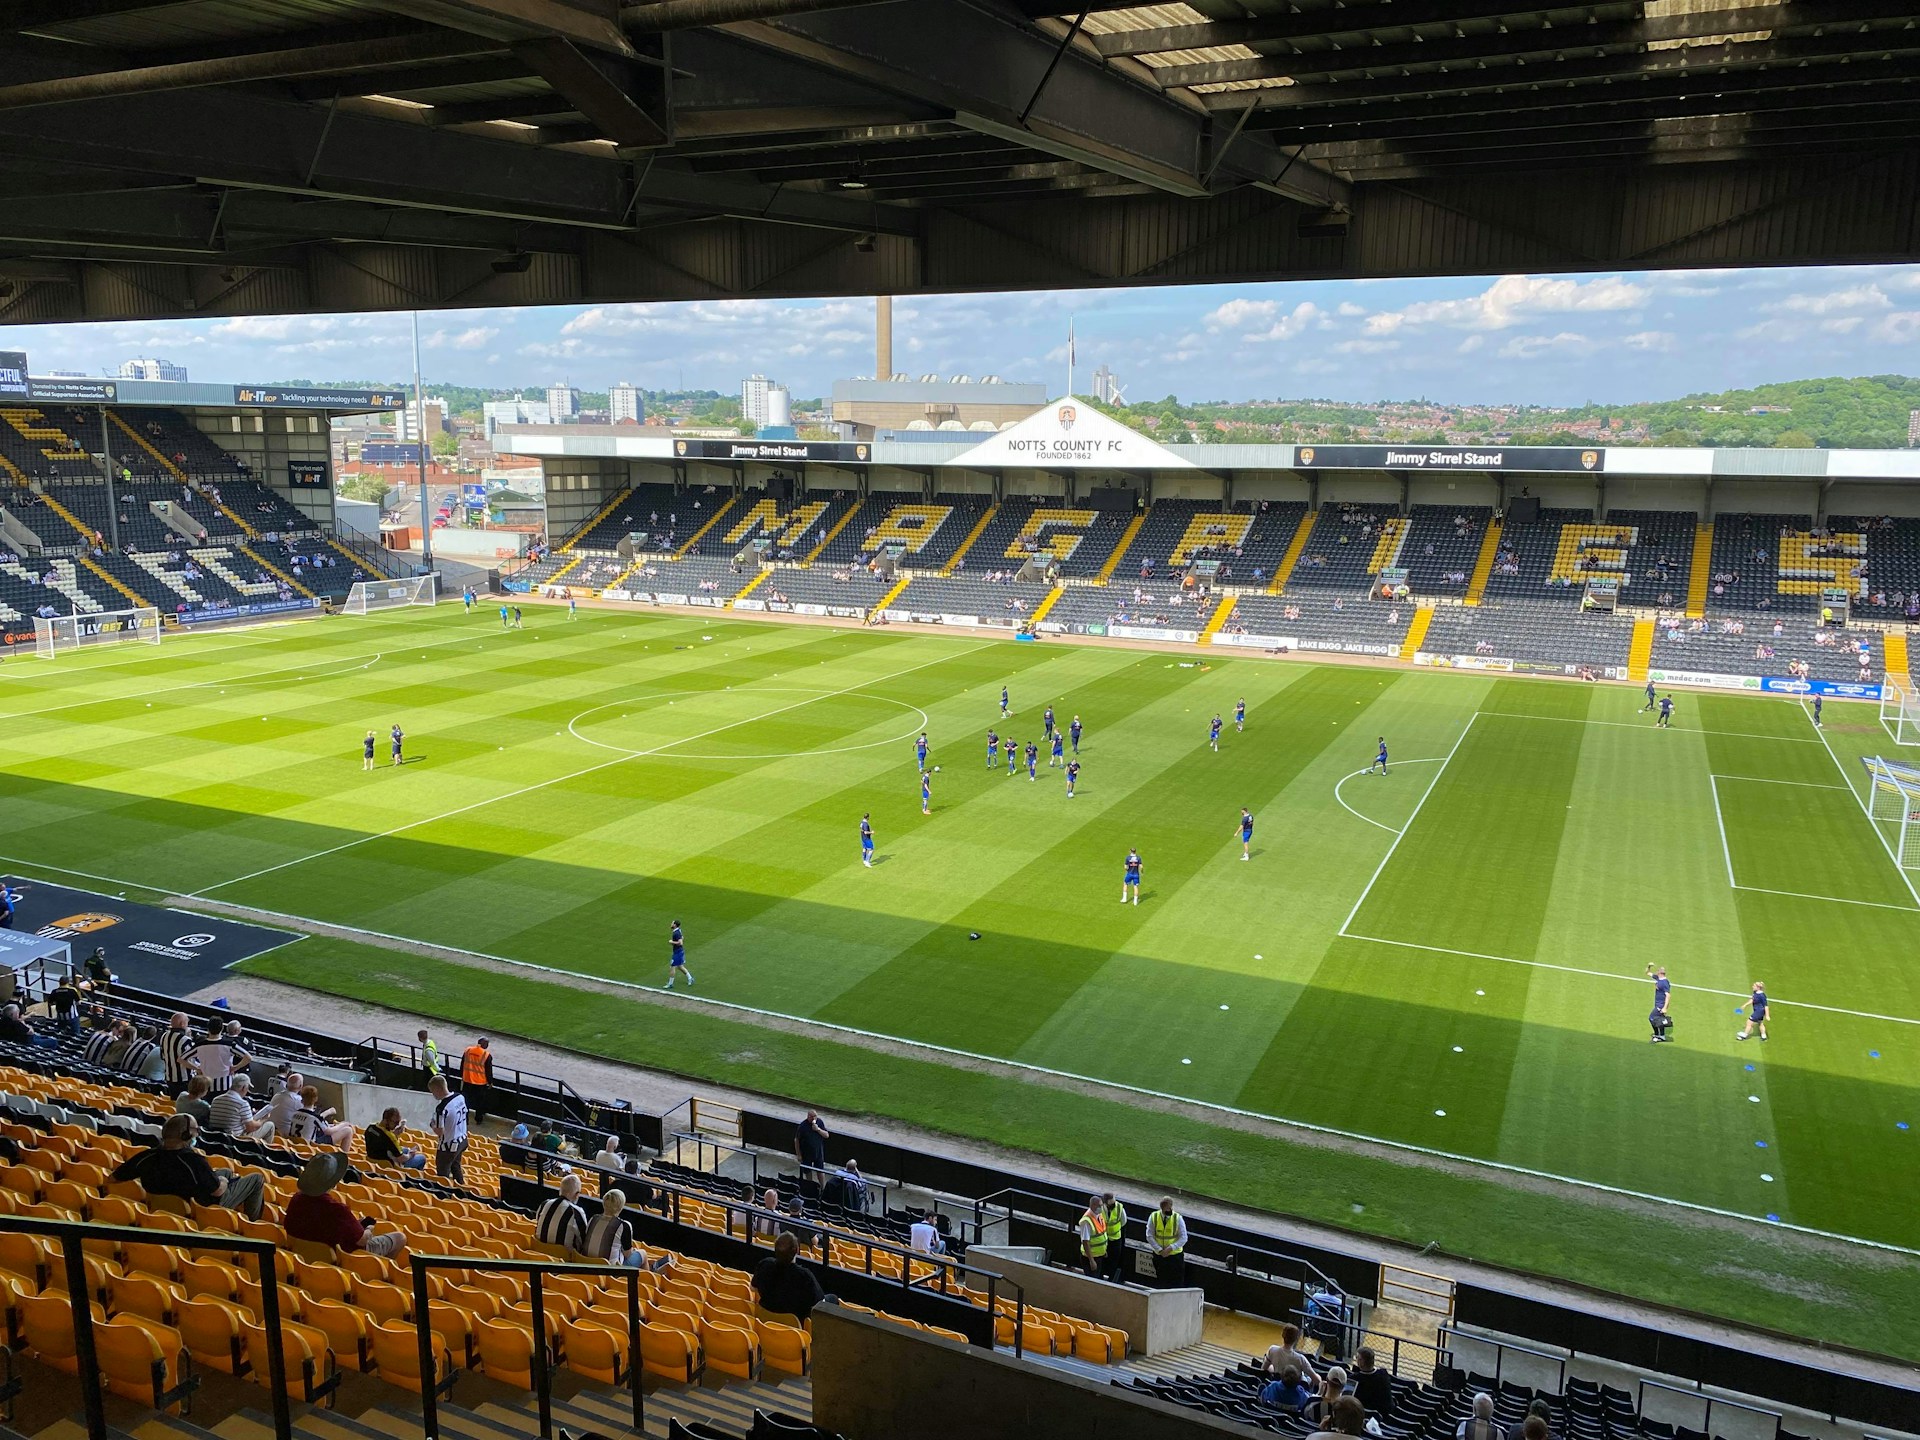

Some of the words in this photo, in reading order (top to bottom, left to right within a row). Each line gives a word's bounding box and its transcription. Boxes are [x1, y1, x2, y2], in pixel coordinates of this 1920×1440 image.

[239, 390, 266, 402] Air-IT
[281, 393, 306, 404] Tackling
[306, 395, 319, 404] your
[320, 396, 351, 404] technology
[351, 396, 368, 404] needs
[371, 395, 393, 406] Air-IT
[731, 445, 758, 457] Jimmy
[759, 445, 782, 456] Sirrel
[783, 446, 808, 457] Stand
[1008, 440, 1046, 451] NOTTS
[1053, 440, 1102, 451] COUNTY
[1108, 440, 1122, 451] FC
[1074, 452, 1091, 460] 1862
[1385, 451, 1427, 466] Jimmy
[1429, 451, 1463, 465] Sirrel
[1464, 452, 1502, 466] Stand
[1035, 622, 1060, 632] PUMA
[1298, 640, 1318, 649] JAKE
[1318, 641, 1342, 650] BUGG
[1343, 643, 1363, 651] JAKE
[1364, 644, 1388, 653] BUGG
